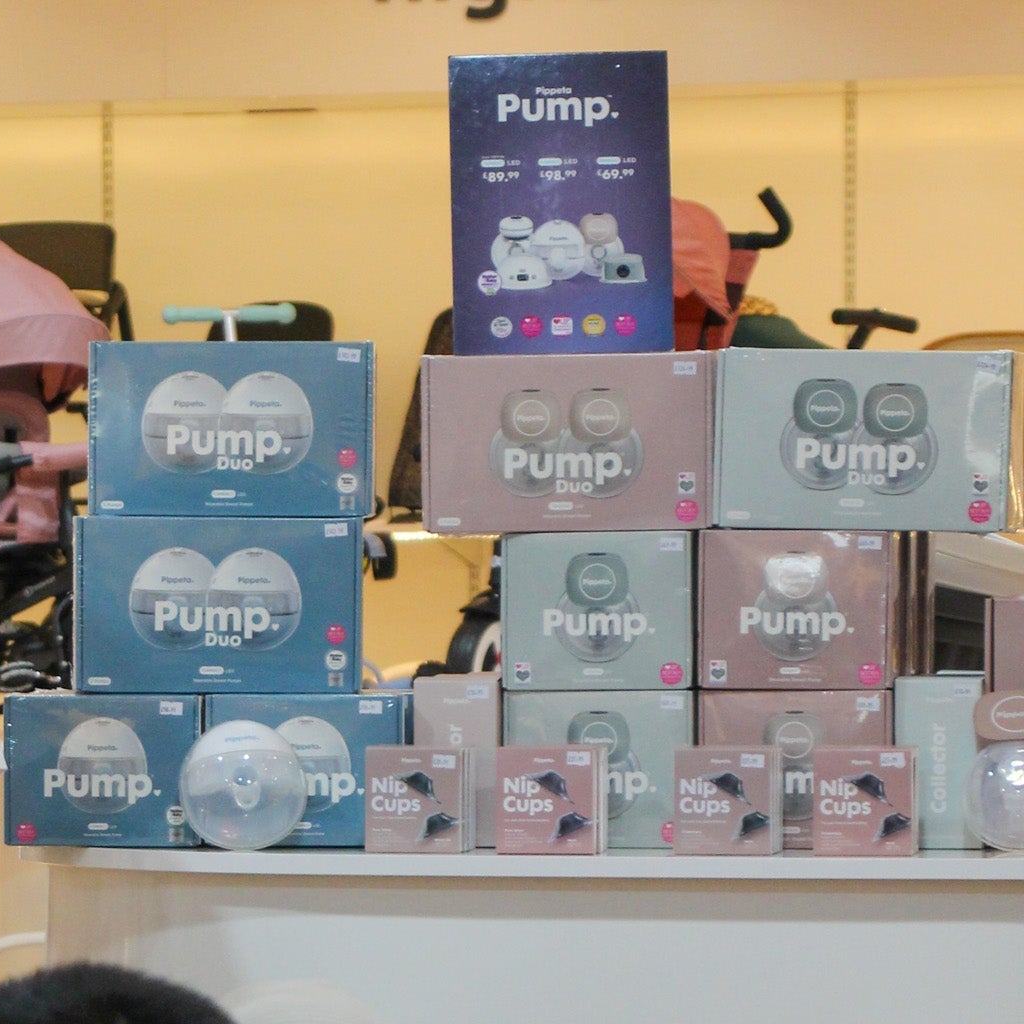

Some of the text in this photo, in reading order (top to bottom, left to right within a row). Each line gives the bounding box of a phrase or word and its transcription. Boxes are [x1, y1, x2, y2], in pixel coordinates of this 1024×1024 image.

[535, 86, 572, 96] Pippeta
[216, 456, 254, 470] Duo
[555, 479, 594, 493] Duo
[848, 471, 886, 486] Duo
[204, 632, 242, 647] Duo
[931, 722, 947, 814] Collector
[371, 775, 408, 797] Nip
[503, 775, 541, 797] Nip
[679, 776, 718, 798] Nip
[819, 777, 858, 800] Nip
[371, 796, 422, 815] Cups
[503, 796, 554, 816] Cups
[679, 797, 731, 817] Cups
[819, 798, 872, 818] Cups
